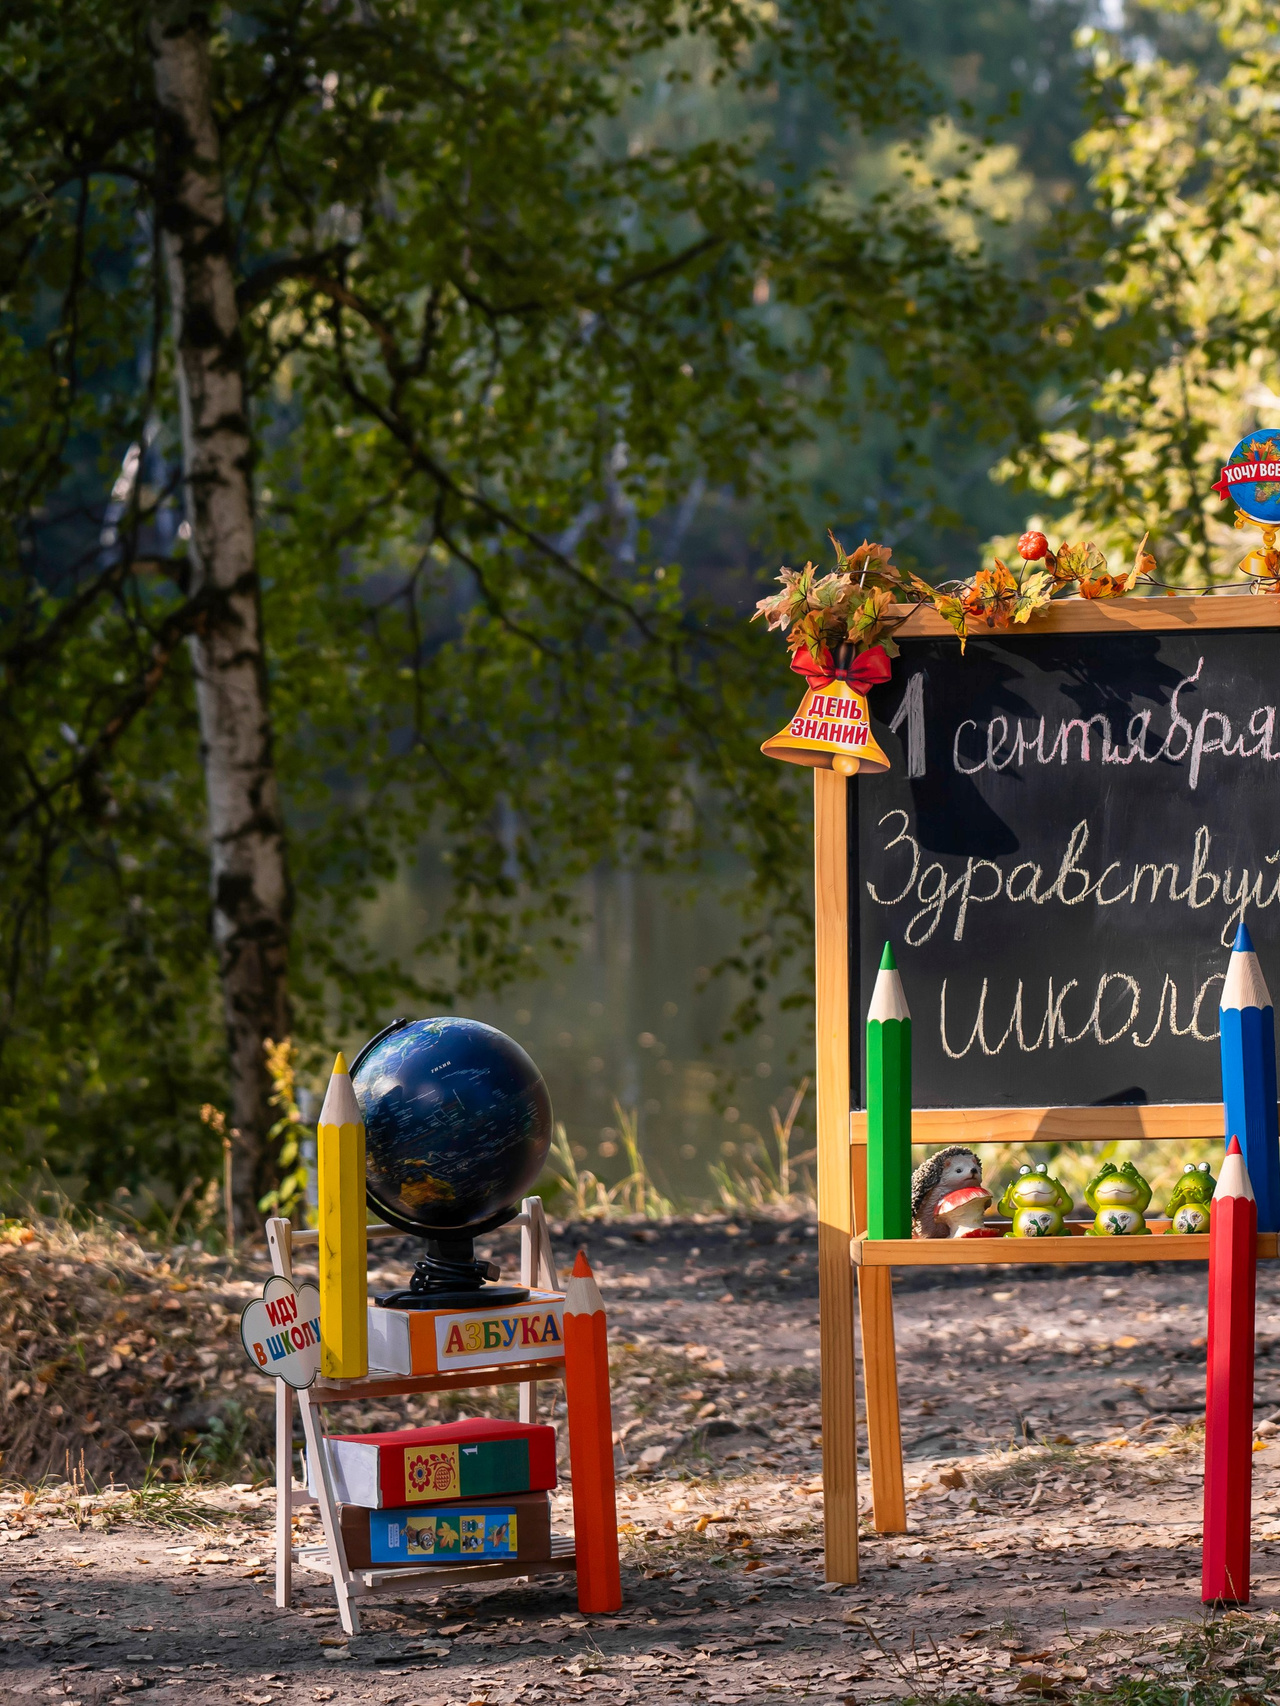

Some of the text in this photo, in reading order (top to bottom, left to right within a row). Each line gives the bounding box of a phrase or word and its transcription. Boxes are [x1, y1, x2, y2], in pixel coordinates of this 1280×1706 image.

[1224, 463, 1258, 483] ХОЧУ
[807, 695, 863, 720] ДЕНЬ
[791, 718, 869, 746] ЗНАНИЙ
[889, 671, 927, 778] 1
[265, 1293, 298, 1327] ИДУ
[253, 1316, 321, 1367] В ШКОЛУ
[446, 1314, 561, 1353] АЗБУКА
[462, 1445, 478, 1456] 1
